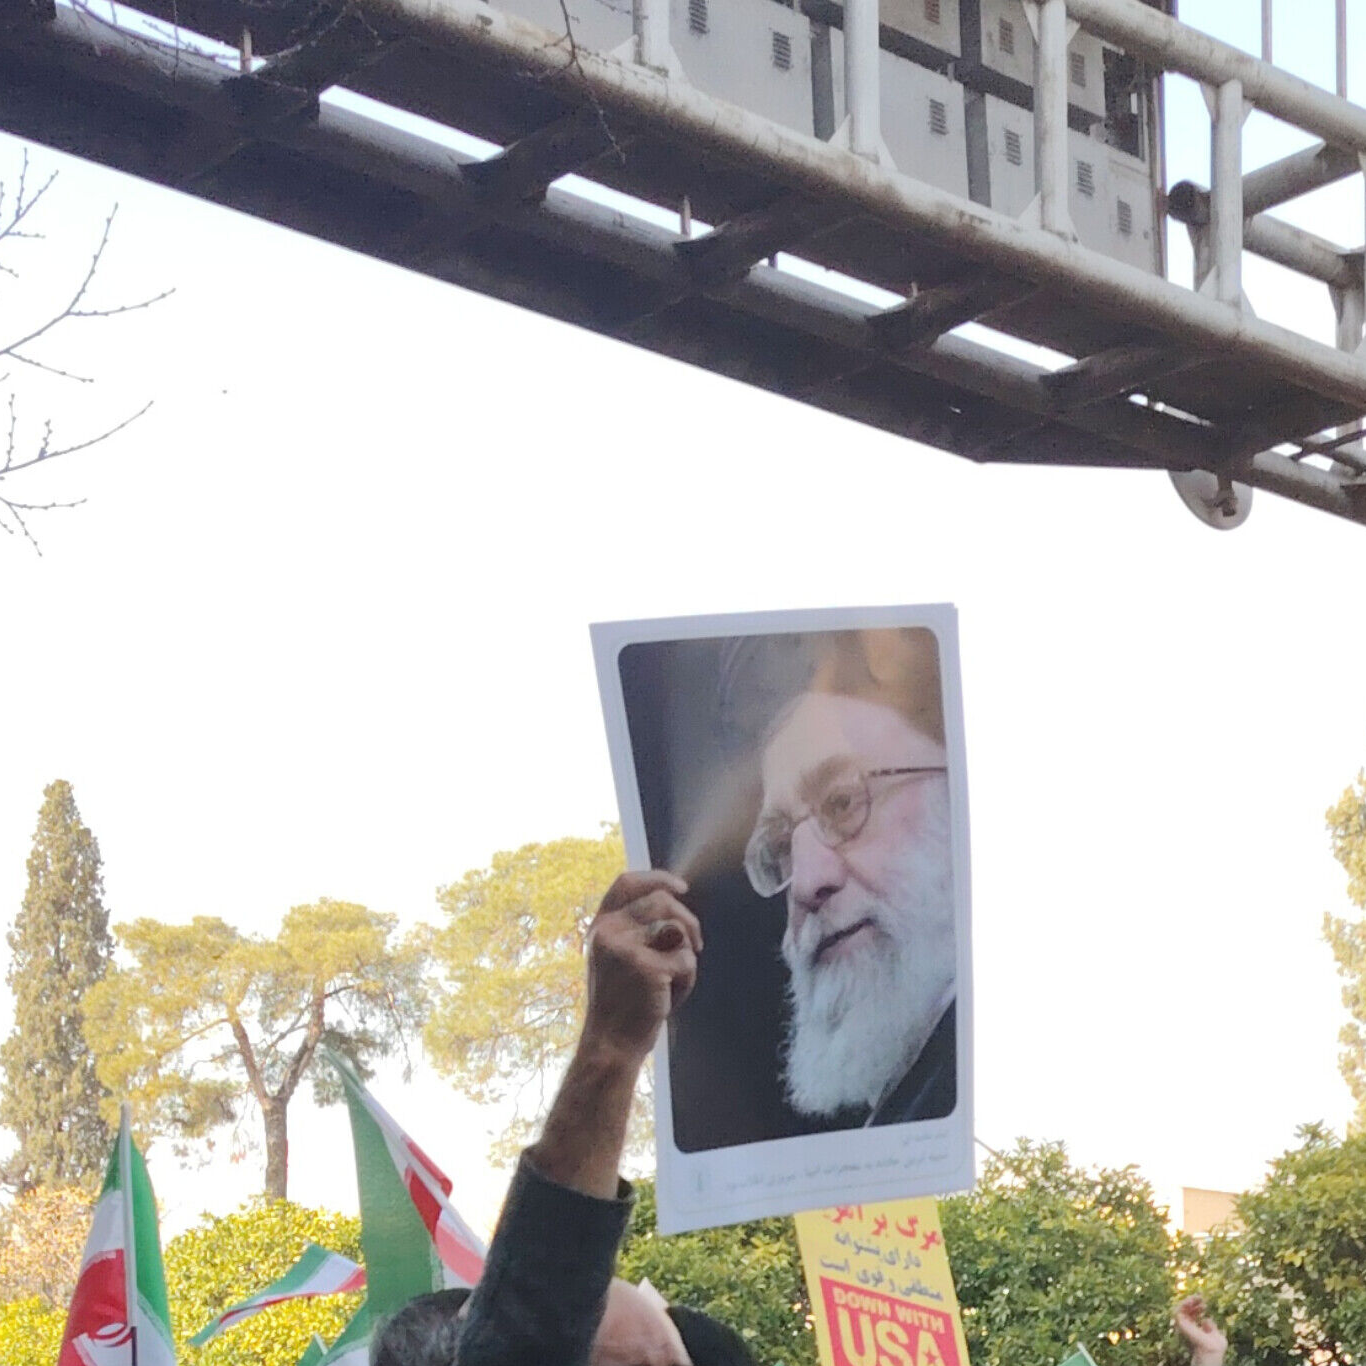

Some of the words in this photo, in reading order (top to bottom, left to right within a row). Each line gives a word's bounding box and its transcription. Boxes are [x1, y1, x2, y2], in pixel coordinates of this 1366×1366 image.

[870, 1212, 889, 1239] بر
[895, 1215, 941, 1251] مرگ
[819, 1253, 851, 1274] است
[832, 1286, 892, 1318] DOWN
[895, 1304, 945, 1334] WITH
